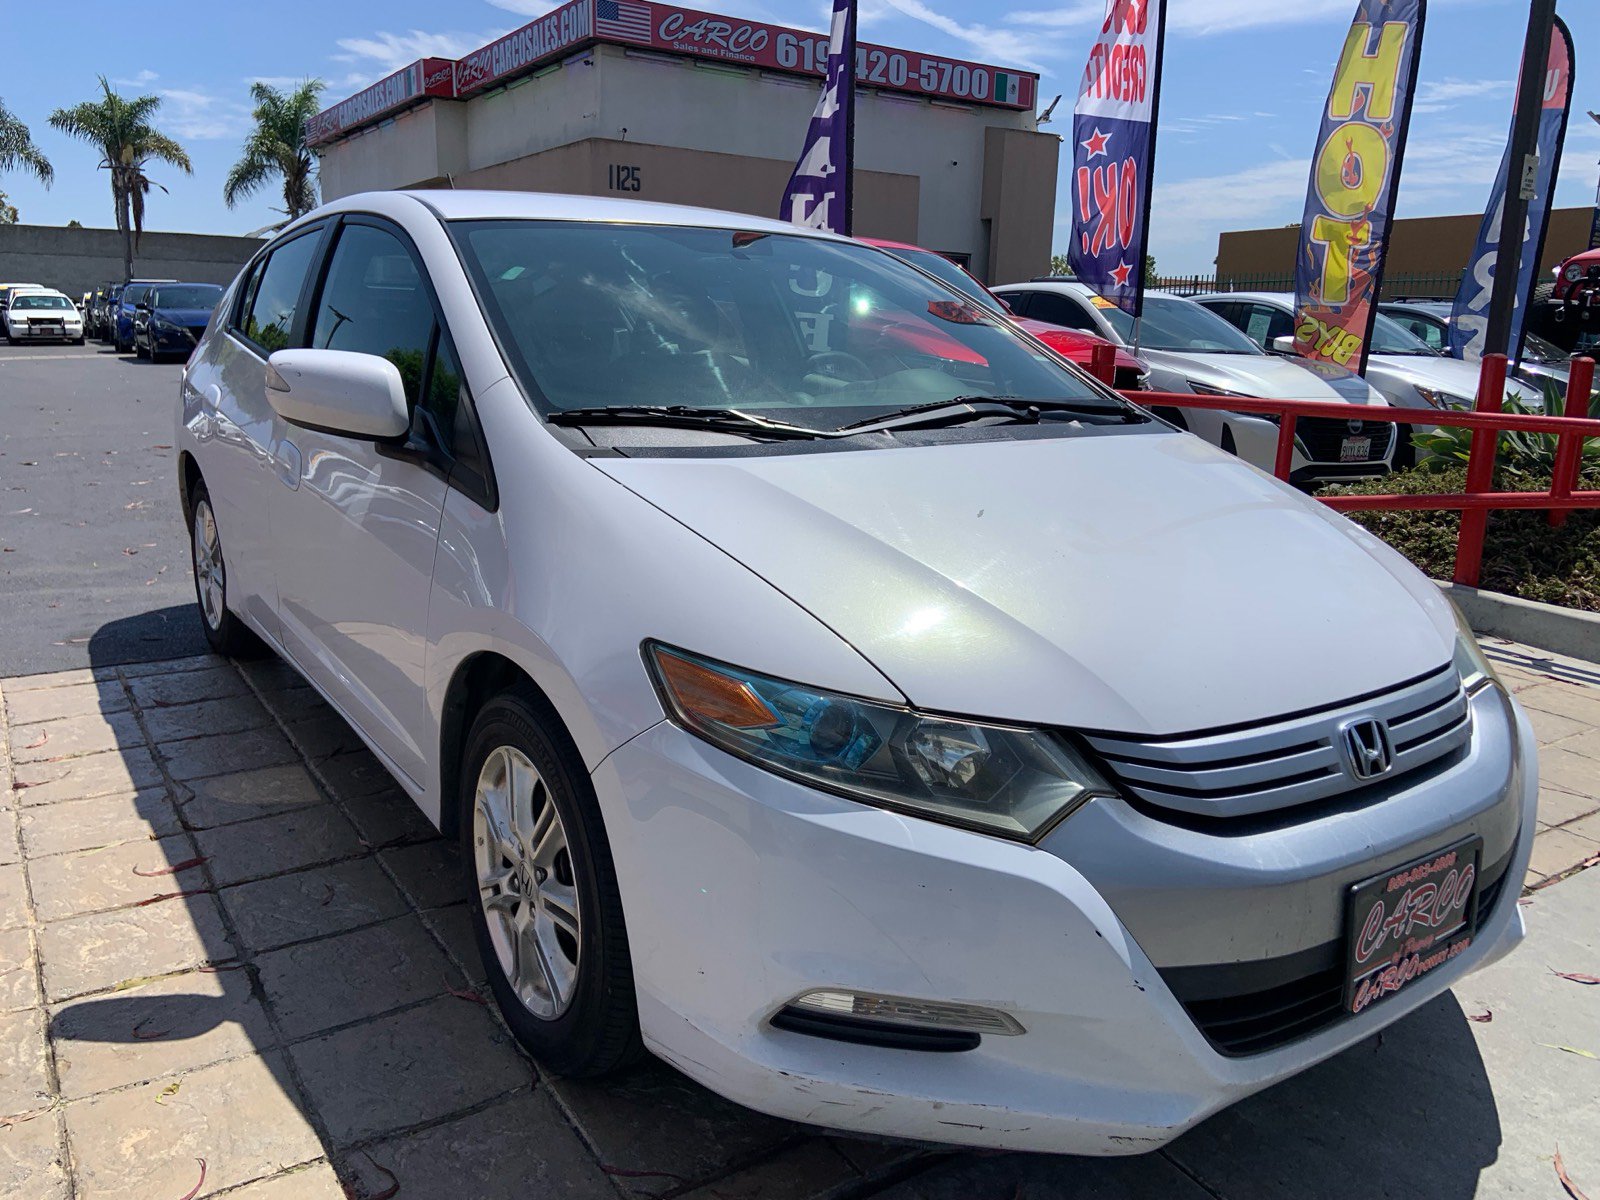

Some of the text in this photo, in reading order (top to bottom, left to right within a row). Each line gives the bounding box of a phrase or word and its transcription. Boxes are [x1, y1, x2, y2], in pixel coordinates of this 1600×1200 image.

[492, 0, 589, 77] CARCOSALES.COM
[658, 13, 769, 53] CARCO
[673, 41, 756, 62] Sales and Finance
[425, 67, 452, 88] CARCO
[457, 50, 492, 88] CARCO
[339, 72, 406, 129] CARCOSALES.COM
[608, 164, 642, 192] 1125
[1310, 21, 1409, 306] HOT
[1355, 863, 1475, 963] CARCO
